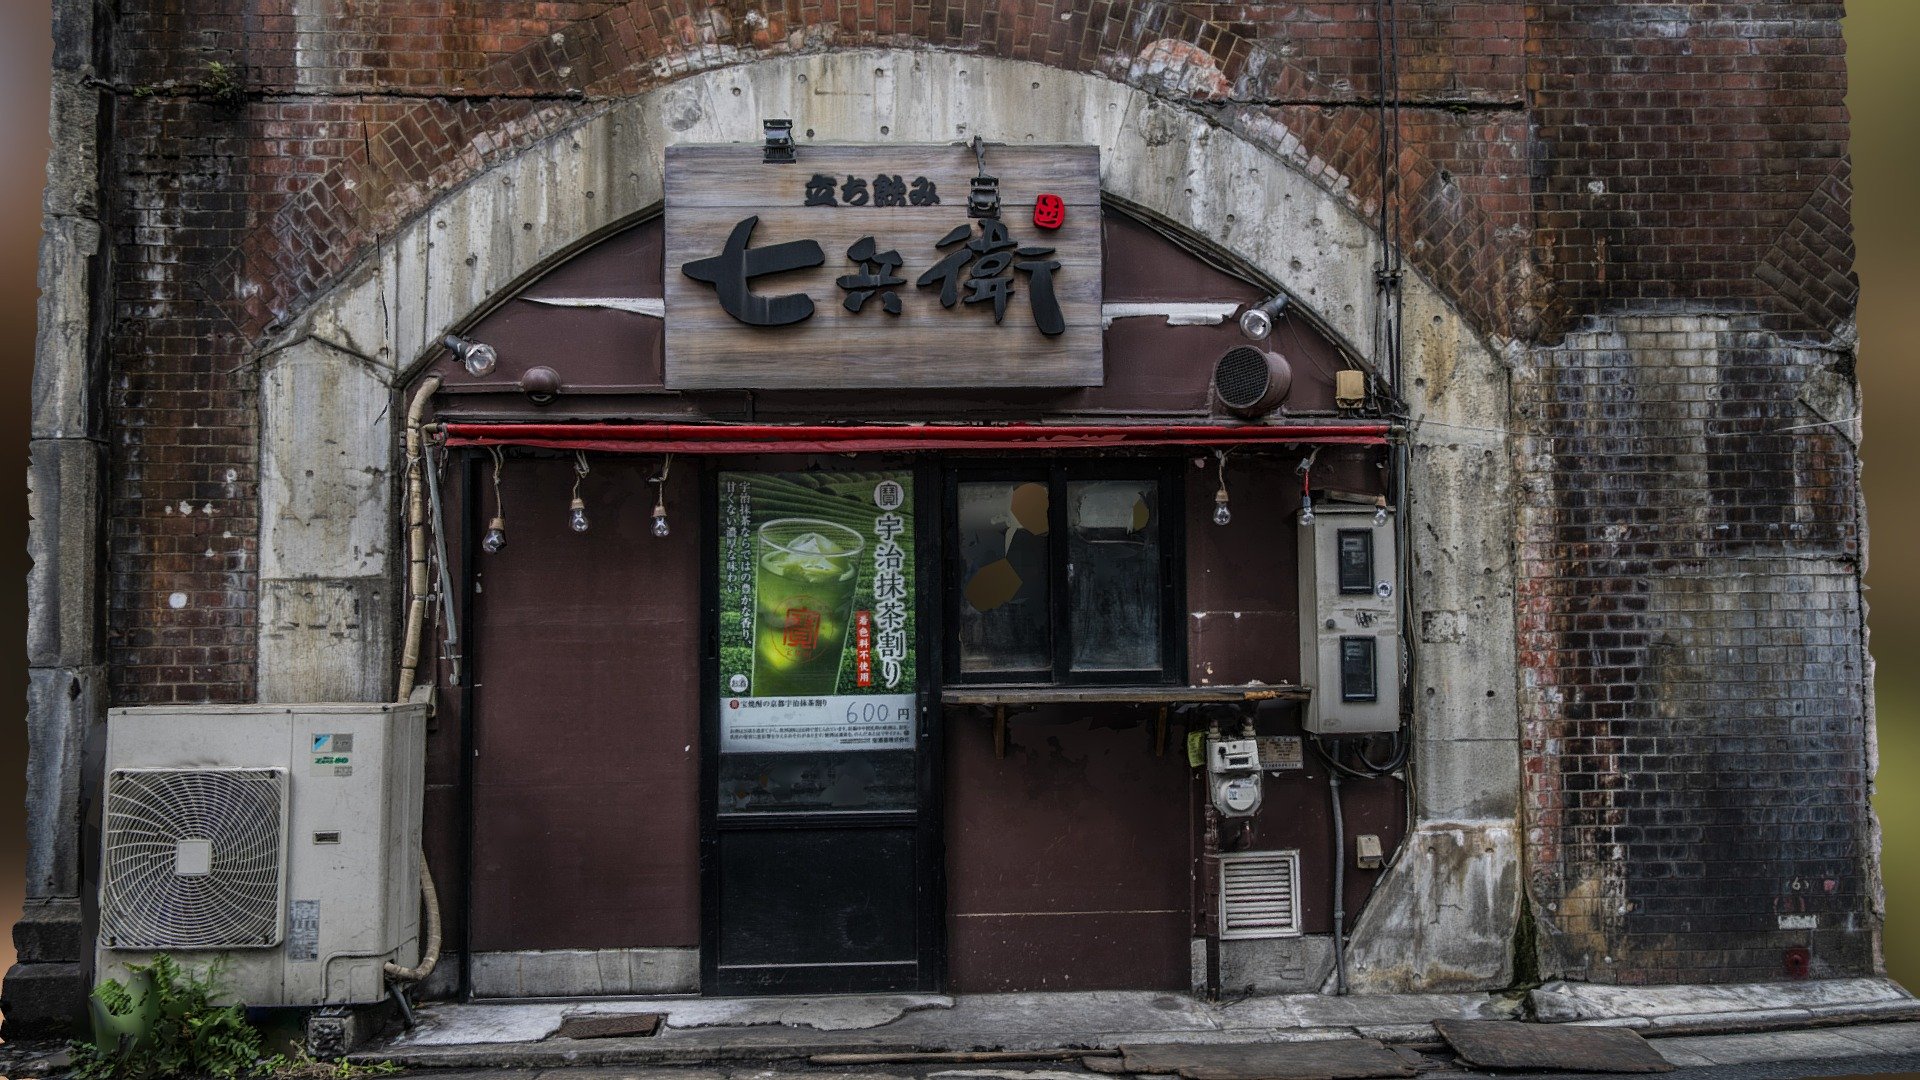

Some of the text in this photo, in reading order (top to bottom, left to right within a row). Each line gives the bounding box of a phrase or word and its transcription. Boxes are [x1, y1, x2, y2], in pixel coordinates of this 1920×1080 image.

[804, 173, 941, 207] 立ち飲み
[681, 215, 1066, 336] 七兵衛
[876, 515, 906, 686] 宇治抹茶割り
[858, 614, 870, 683] 着色料不使用
[846, 701, 910, 724] 600 円
